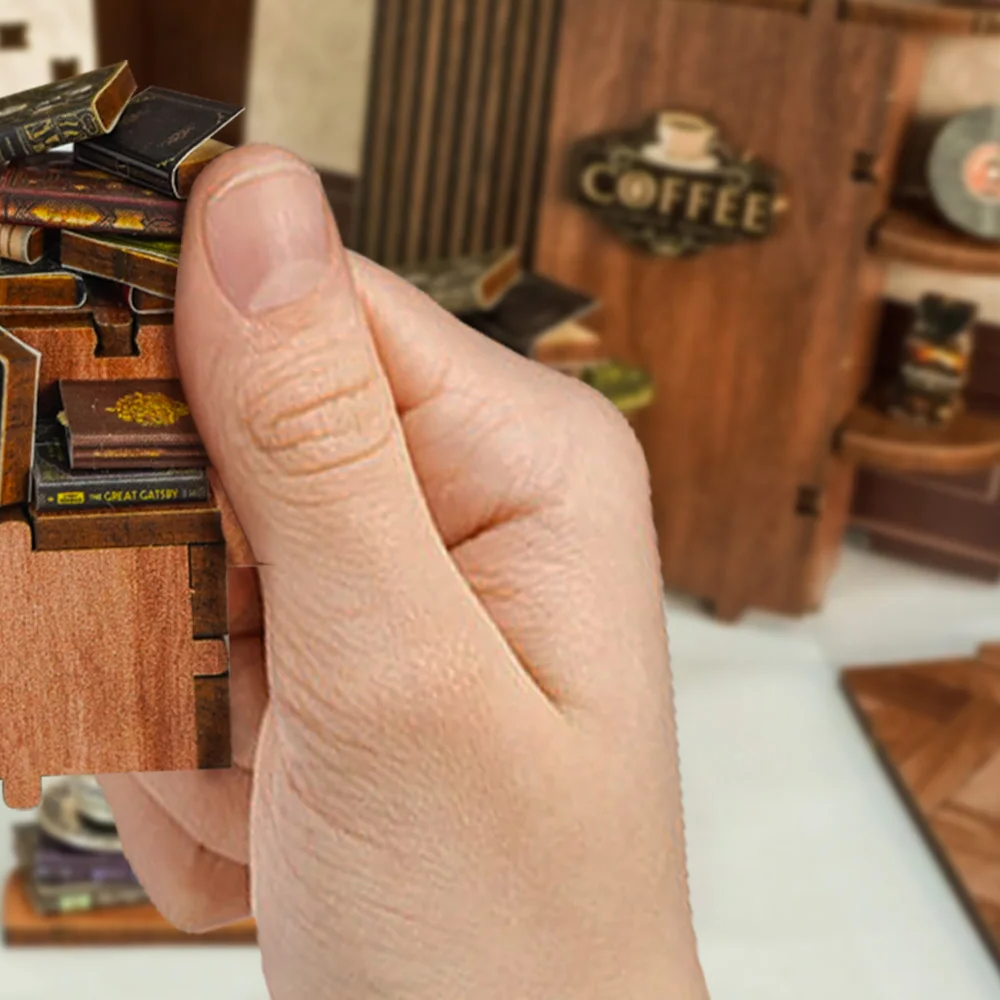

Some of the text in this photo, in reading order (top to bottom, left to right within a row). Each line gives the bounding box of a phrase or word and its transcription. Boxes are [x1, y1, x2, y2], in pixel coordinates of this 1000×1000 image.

[580, 161, 768, 236] COFFEE
[103, 489, 138, 502] GREAT
[139, 487, 179, 501] GATSBY
